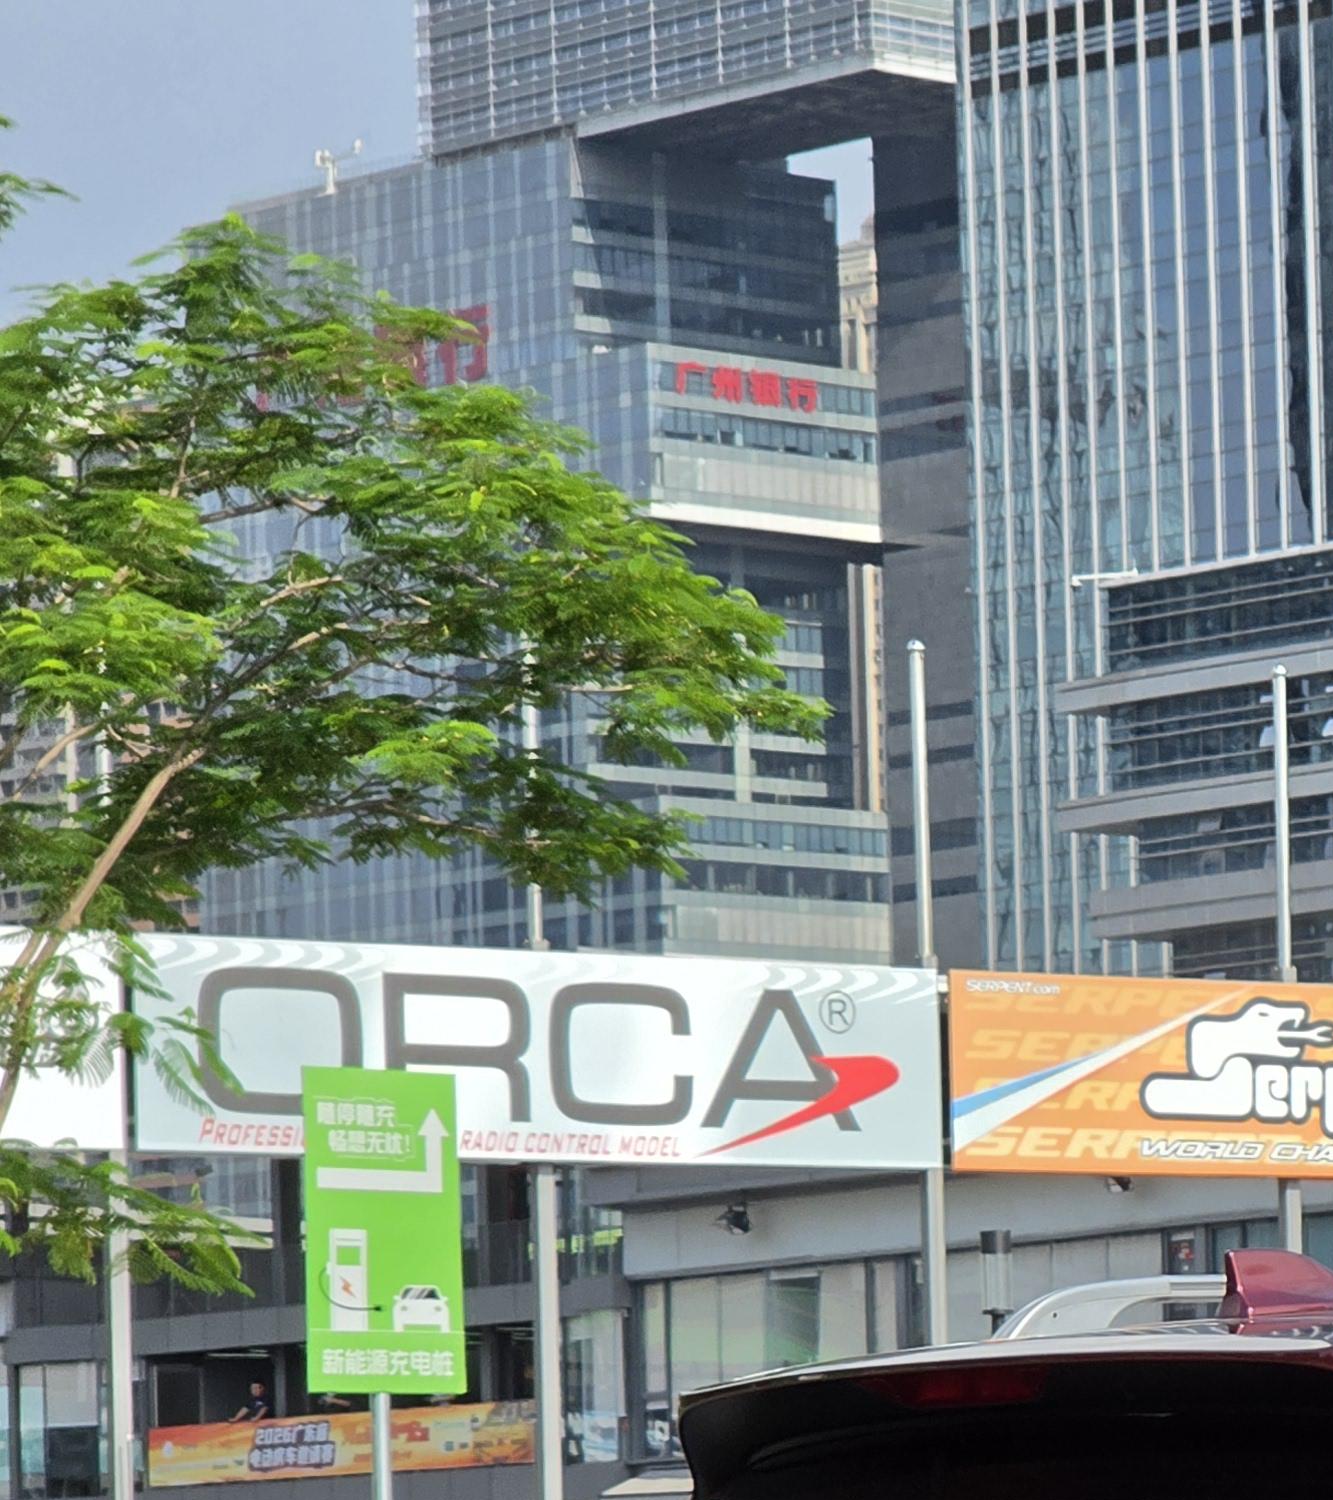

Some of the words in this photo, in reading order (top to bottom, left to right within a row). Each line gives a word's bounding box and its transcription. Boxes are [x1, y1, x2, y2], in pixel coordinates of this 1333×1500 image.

[675, 361, 818, 414] 广州银行
[460, 1130, 517, 1152] RADIO
[523, 1133, 612, 1156] CONTROL
[618, 1136, 682, 1158] MODEL
[1141, 1138, 1264, 1161] WORLD
[321, 1348, 455, 1377] 新能源充电桩
